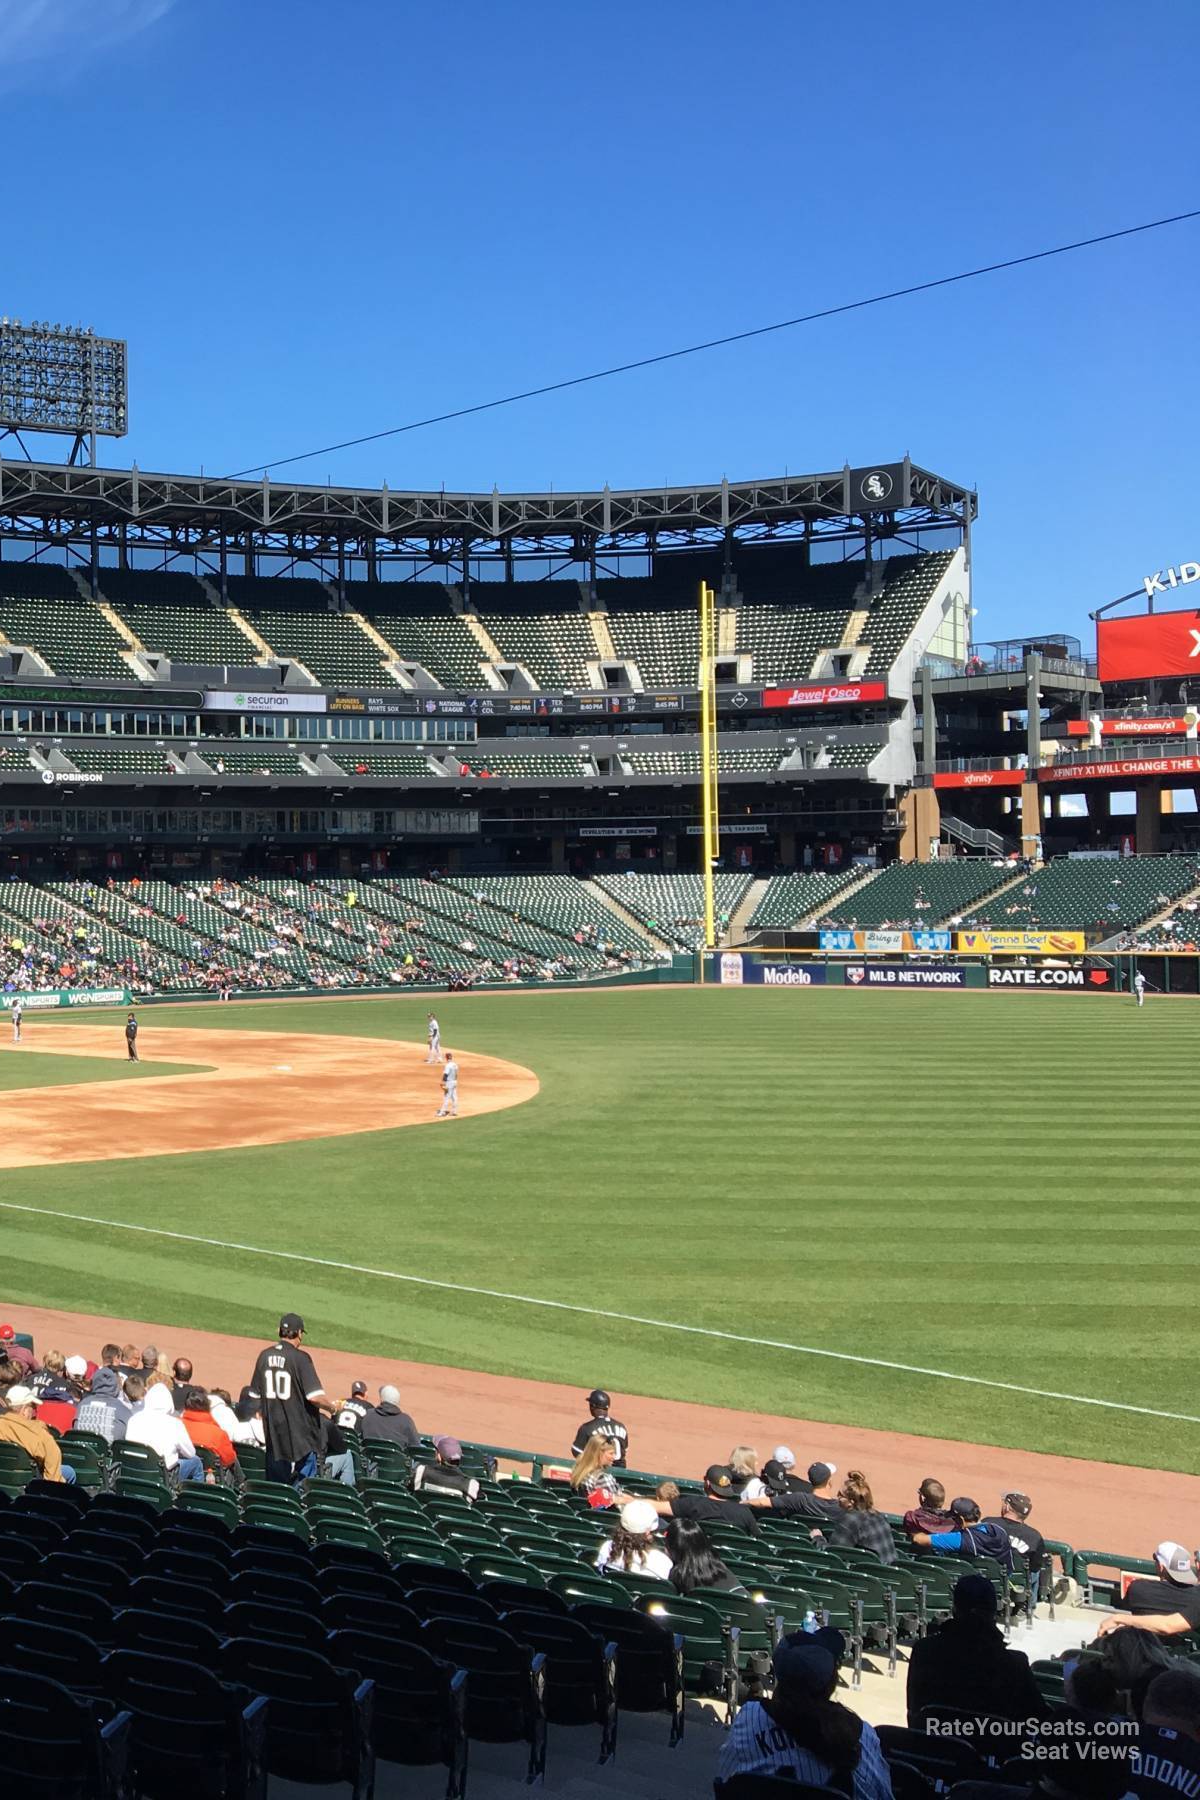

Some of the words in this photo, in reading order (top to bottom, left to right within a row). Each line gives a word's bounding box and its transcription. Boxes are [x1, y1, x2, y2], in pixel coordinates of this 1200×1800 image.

[247, 695, 289, 705] securian
[791, 687, 861, 701] Jewel-Osco
[1053, 766, 1084, 778] XFINITY
[1085, 765, 1096, 775] X1
[1097, 763, 1121, 775] WILL
[1122, 760, 1168, 773] CHANGE
[1170, 759, 1194, 770] THE
[56, 773, 103, 782] ROBINSON
[963, 773, 993, 785] xfinity
[867, 931, 892, 943] Bring
[982, 933, 1020, 944] Vienna
[1023, 935, 1048, 944] Beef
[763, 966, 811, 985] Modelo
[869, 971, 895, 982] MLB
[898, 971, 962, 983] NETWORK
[989, 968, 1085, 985] RATE.COM
[264, 1369, 291, 1400] 10
